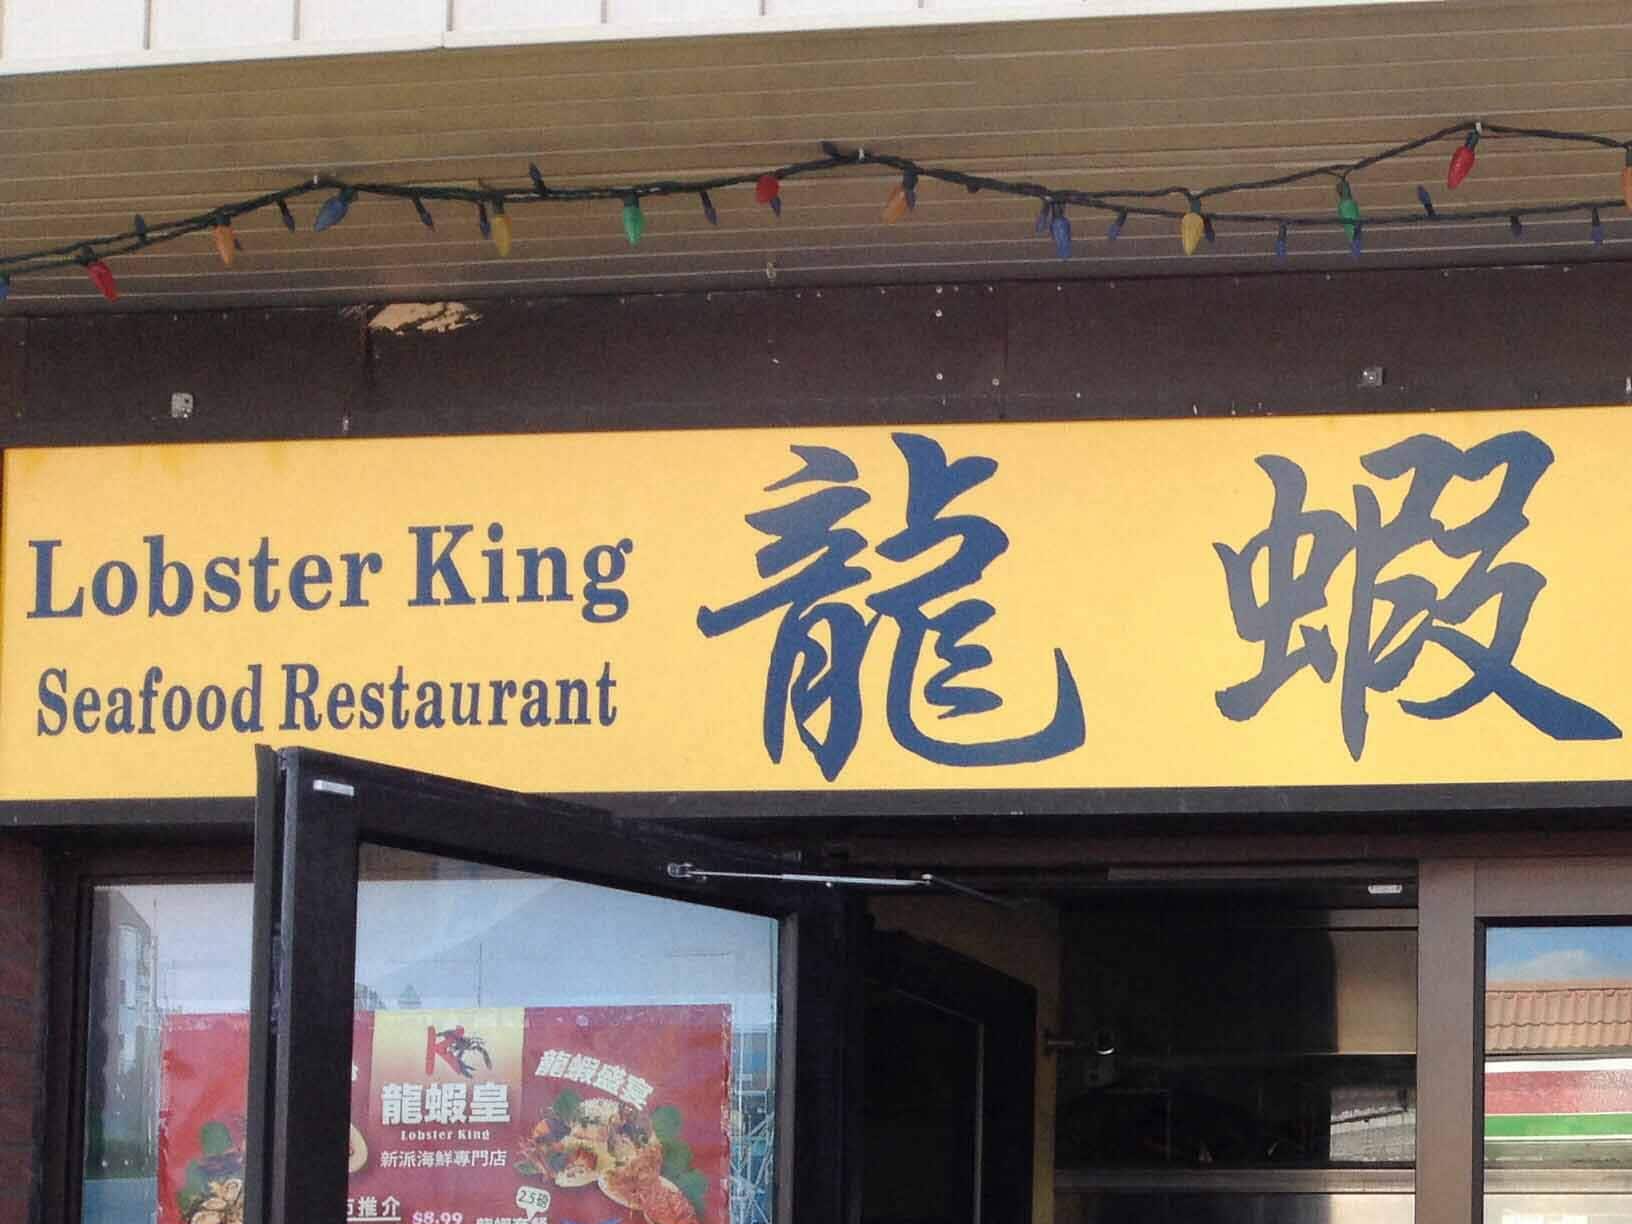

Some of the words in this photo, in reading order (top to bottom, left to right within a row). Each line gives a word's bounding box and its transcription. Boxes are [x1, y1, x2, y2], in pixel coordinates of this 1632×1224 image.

[26, 531, 383, 620] Lobster
[406, 521, 635, 624] King
[35, 664, 266, 738] Seafood
[276, 659, 620, 734] Restaurant
[381, 1081, 511, 1126] 龍蝦皇
[400, 1129, 453, 1142] Lobster
[457, 1128, 491, 1142] King
[379, 1149, 507, 1169] 新派海鮮專門店
